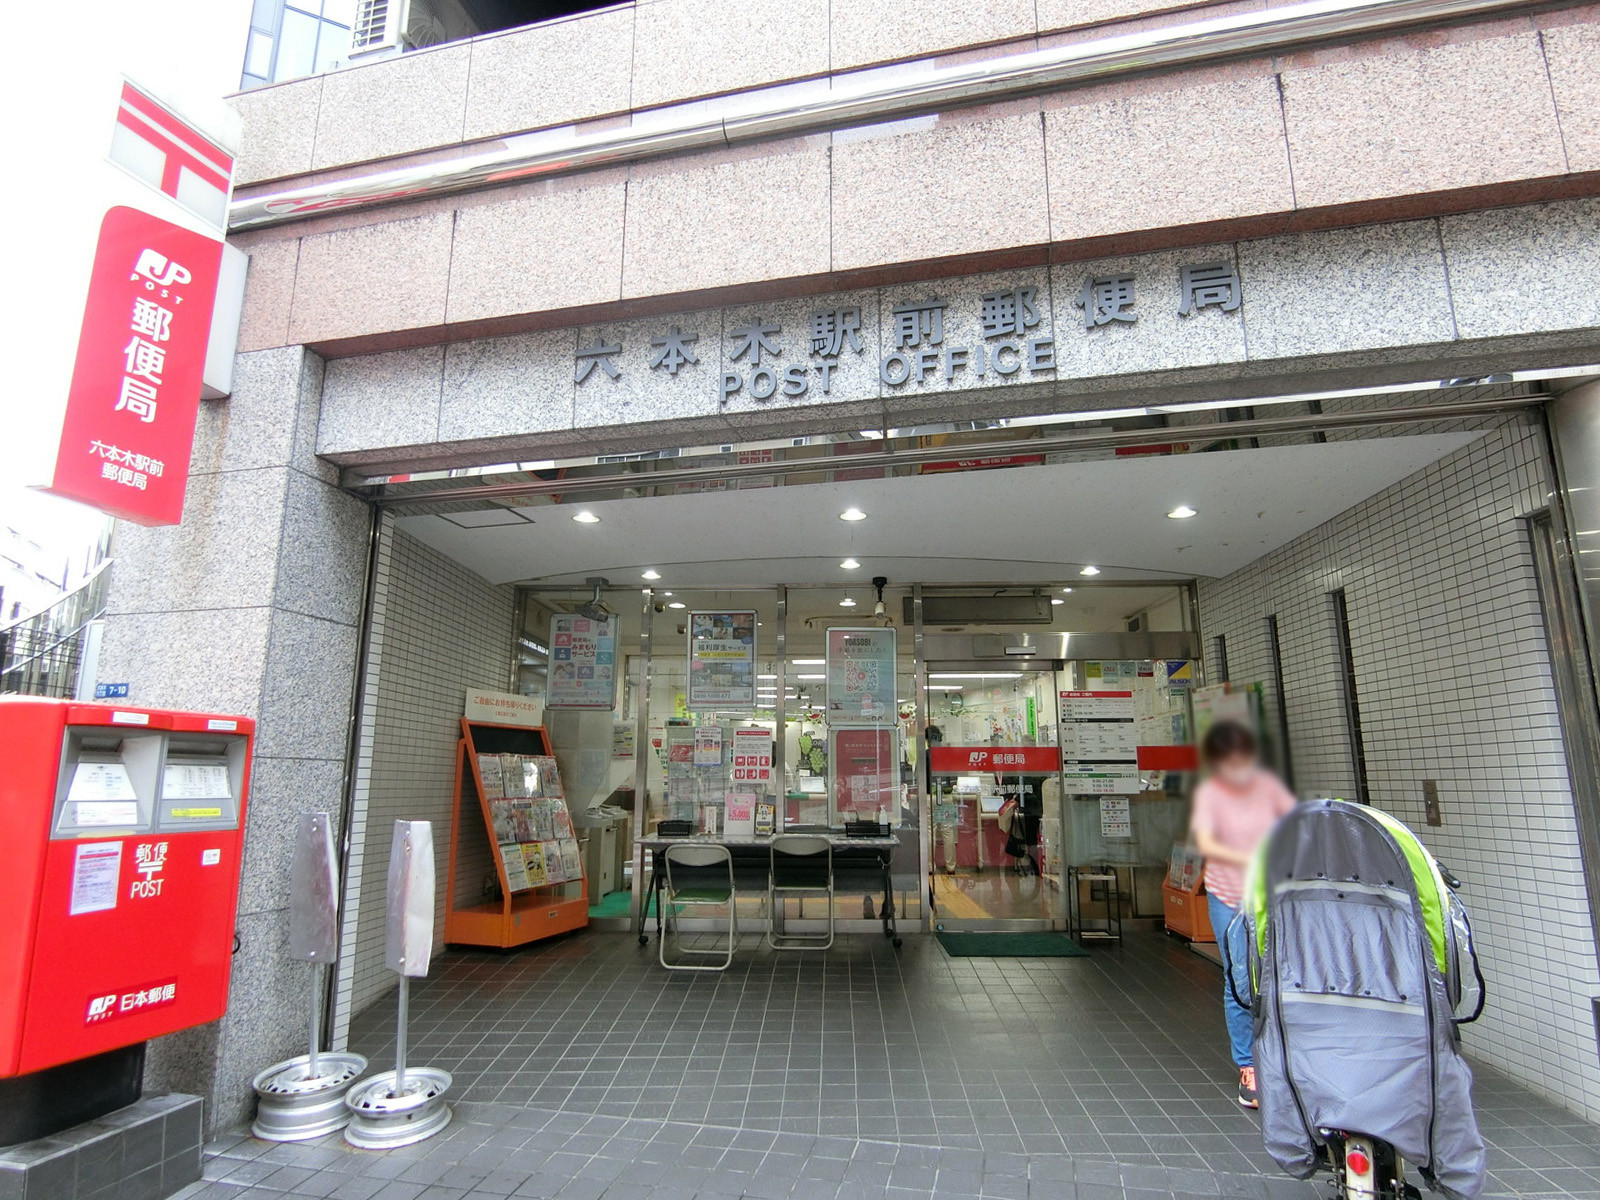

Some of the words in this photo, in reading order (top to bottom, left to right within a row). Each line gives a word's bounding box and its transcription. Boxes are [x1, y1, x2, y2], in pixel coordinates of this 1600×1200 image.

[130, 273, 184, 304] POST
[575, 264, 1242, 383] 六本木駅前郵便局
[114, 296, 173, 424] 郵便局
[719, 359, 838, 404] POST
[879, 337, 1056, 388] OFFICE
[89, 439, 165, 478] 六本木駅前
[102, 461, 148, 491] 郵便局
[992, 753, 1026, 765] 郵便局
[135, 842, 169, 864] 郵便
[130, 878, 165, 899] POST
[121, 983, 176, 1012] 日本郵便
